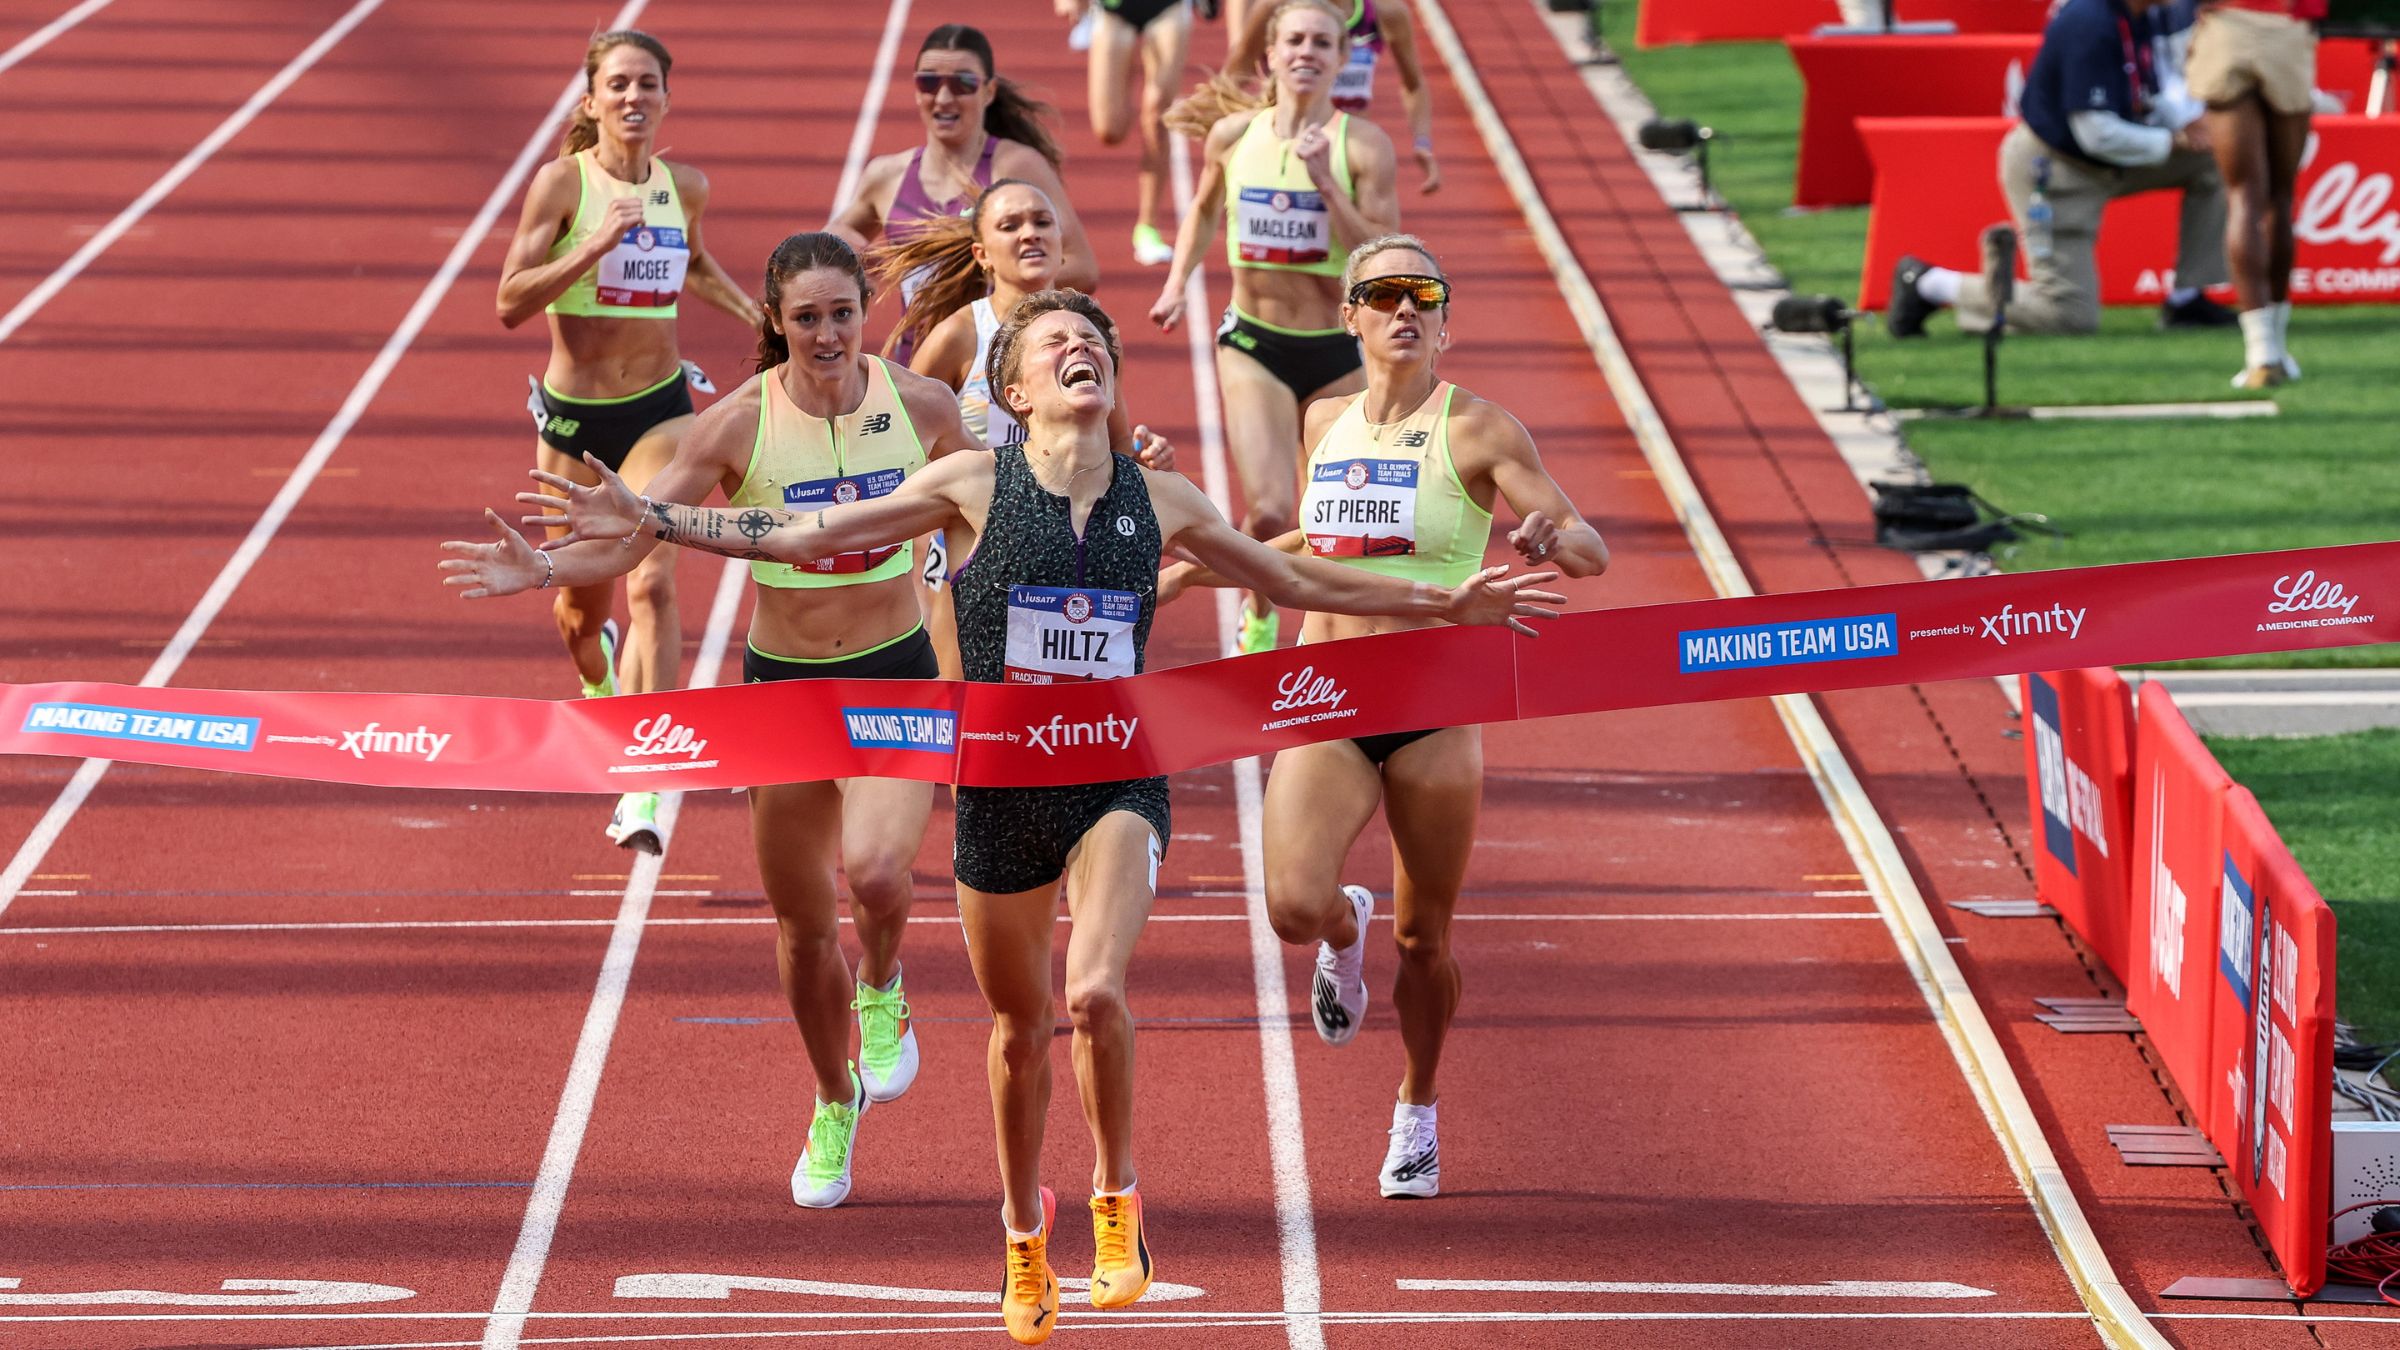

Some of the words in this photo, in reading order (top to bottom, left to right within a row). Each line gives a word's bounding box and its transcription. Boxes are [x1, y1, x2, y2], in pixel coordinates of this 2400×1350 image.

[1249, 218, 1317, 239] MACLEAN
[623, 260, 670, 280] MCGEE
[867, 483, 881, 491] TEAM
[882, 479, 899, 488] TRIALS
[878, 472, 898, 482] OLYMPIC
[801, 487, 825, 497] USATF
[1314, 500, 1334, 523] ST
[1338, 499, 1401, 524] PIERRE
[1030, 596, 1057, 604] USATF
[2268, 570, 2359, 614] Lilly
[1102, 602, 1116, 610] TEAM
[1116, 603, 1134, 611] TRIALS
[1909, 624, 1960, 640] presented
[1962, 623, 1975, 636] by
[1979, 602, 2086, 645] xfinity
[2256, 624, 2265, 632] A
[2265, 619, 2319, 631] MEDICINE
[2320, 614, 2375, 627] COMPANY
[1042, 628, 1109, 662] HILTZ
[1686, 632, 1771, 665] MAKING
[1777, 626, 1836, 657] TEAM
[1844, 622, 1890, 651] USA
[1271, 666, 1347, 711] Lilly
[30, 707, 127, 733] MAKING
[129, 714, 195, 740] TEAM
[197, 720, 249, 745] USA
[847, 714, 903, 741] MAKING
[902, 715, 933, 744] TEAM
[936, 717, 953, 746] USA
[960, 731, 1004, 742] presented
[1007, 732, 1021, 744] by
[1025, 713, 1138, 755] xfinity
[1261, 723, 1269, 732] A
[1269, 715, 1310, 730] MEDICINE
[1311, 708, 1358, 722] COMPANY
[337, 721, 452, 761] xfinity
[624, 713, 708, 759] Lilly
